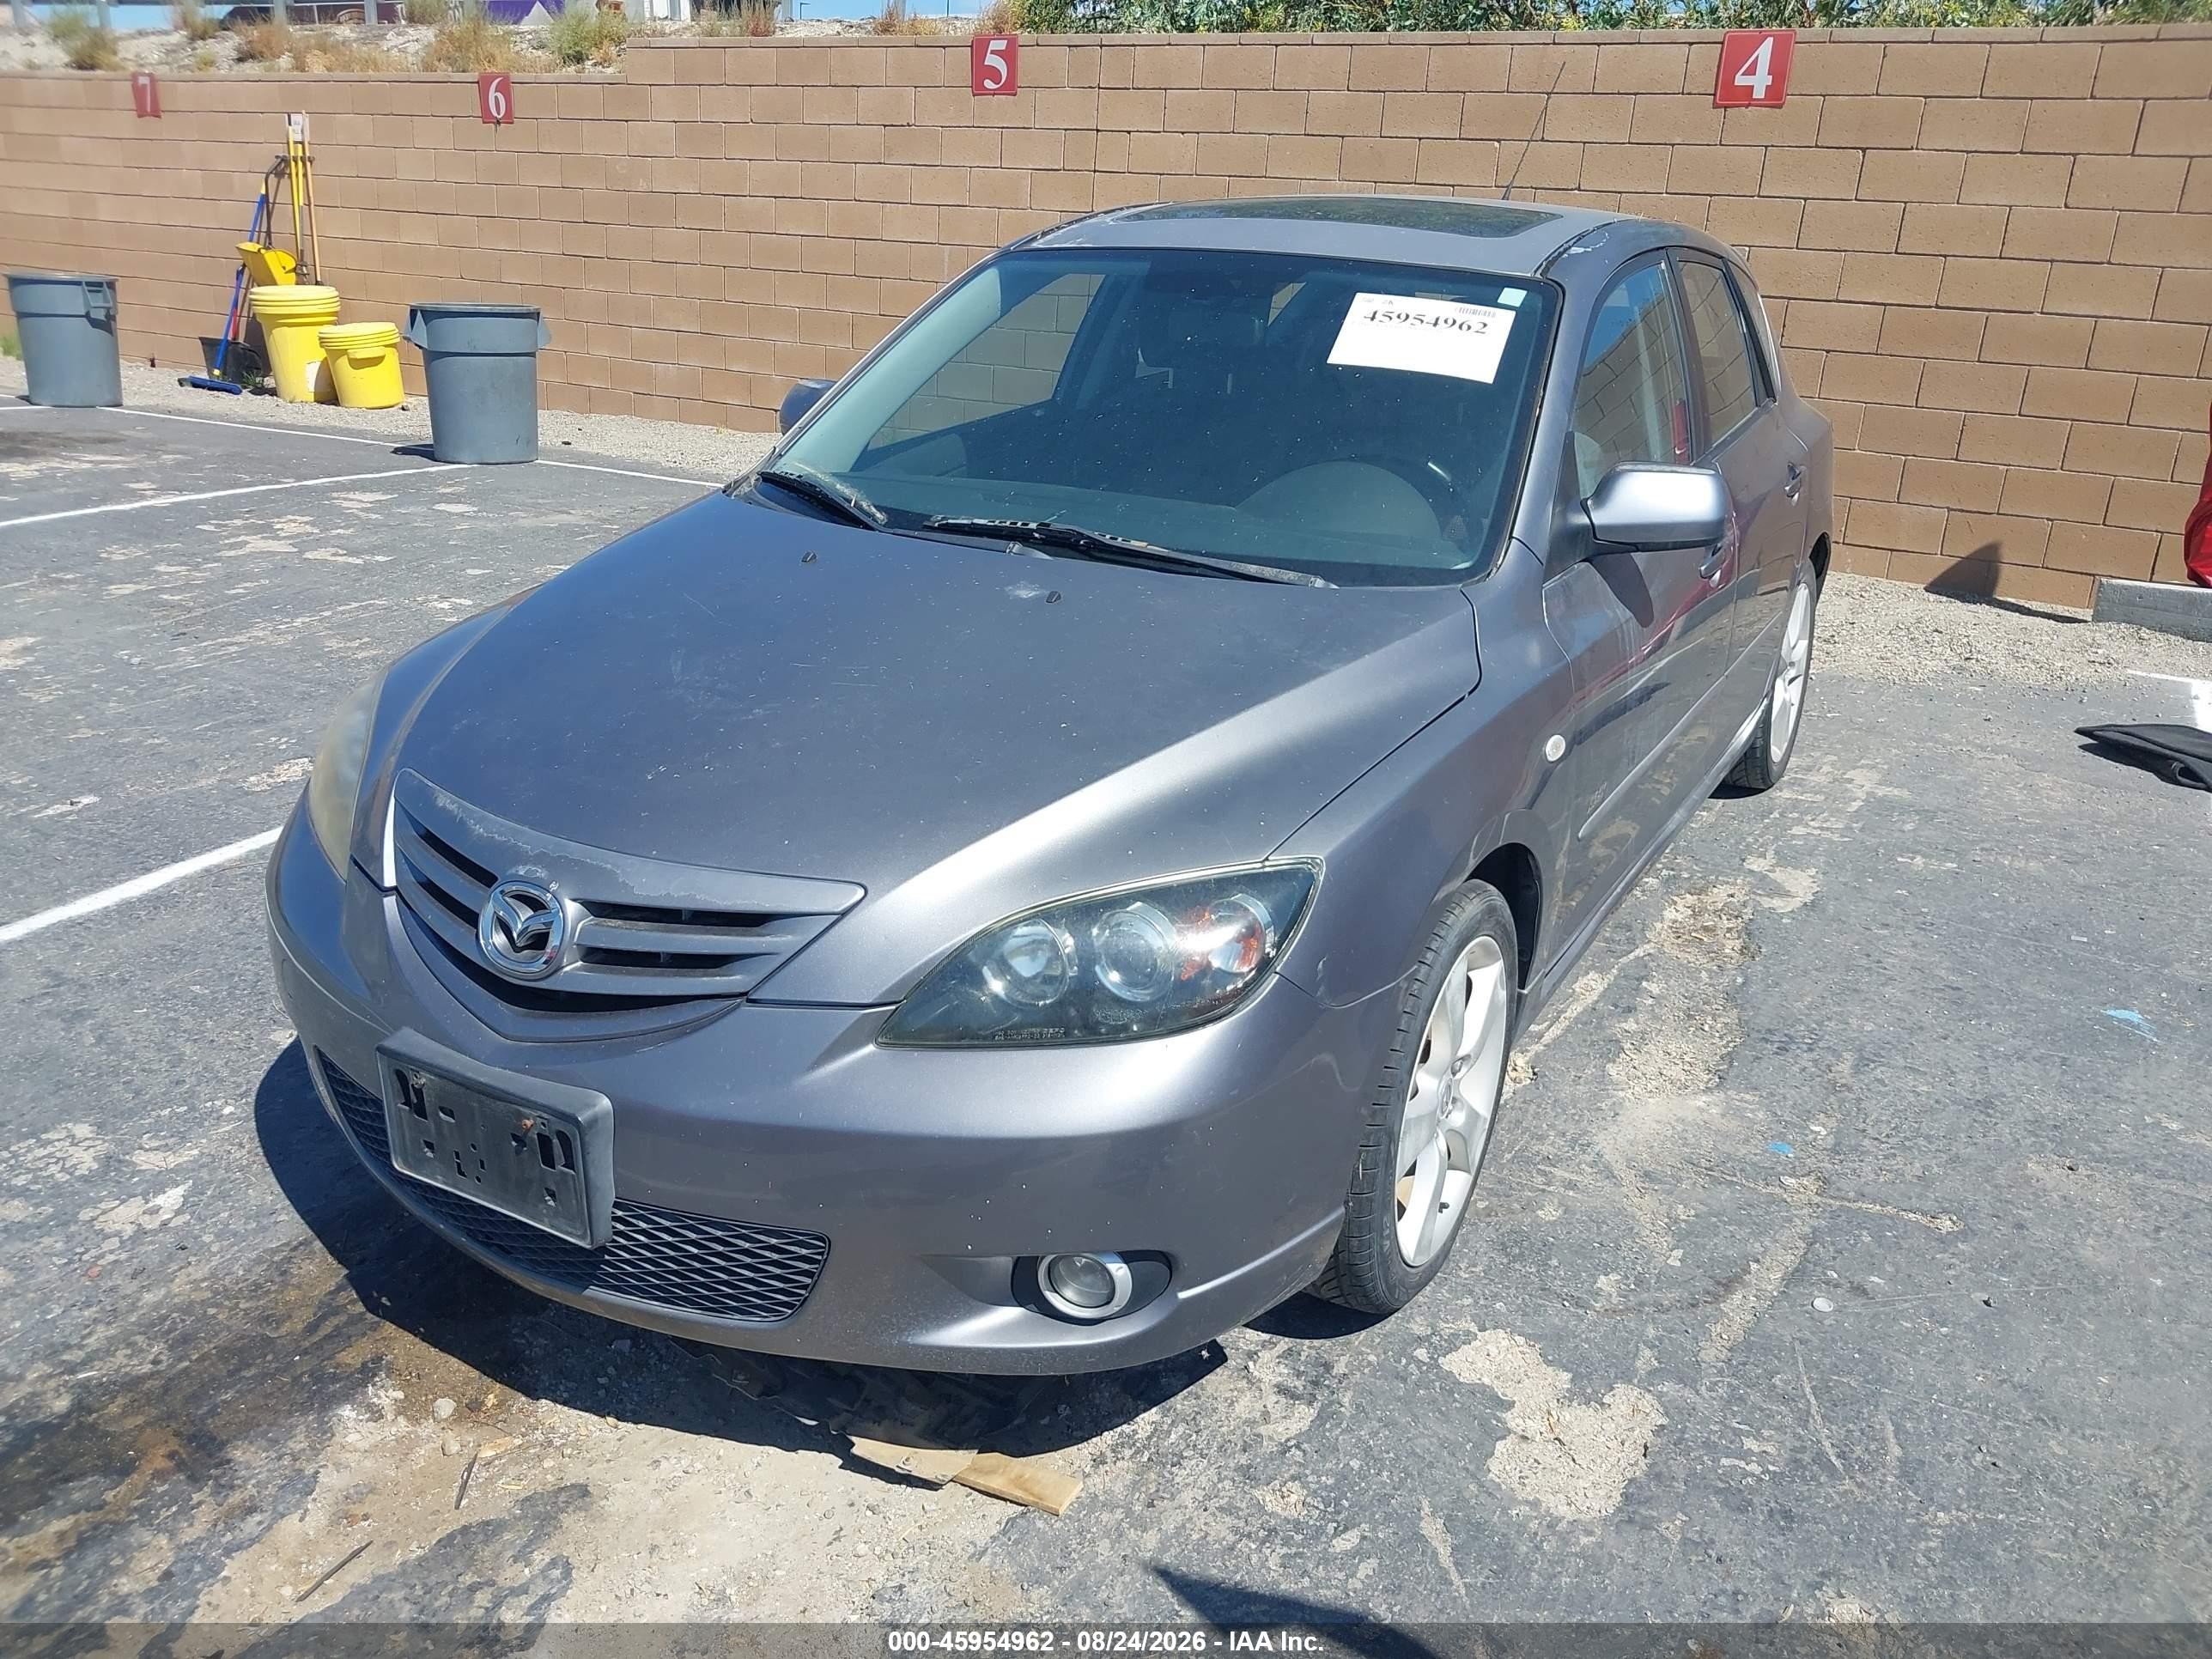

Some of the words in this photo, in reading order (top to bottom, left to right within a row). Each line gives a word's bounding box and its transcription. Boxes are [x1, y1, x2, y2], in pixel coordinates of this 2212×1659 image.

[983, 40, 1008, 89] 5
[1734, 36, 1774, 99] 4
[138, 76, 151, 112] 7
[489, 76, 506, 118] 6
[1364, 309, 1489, 335] 45954962
